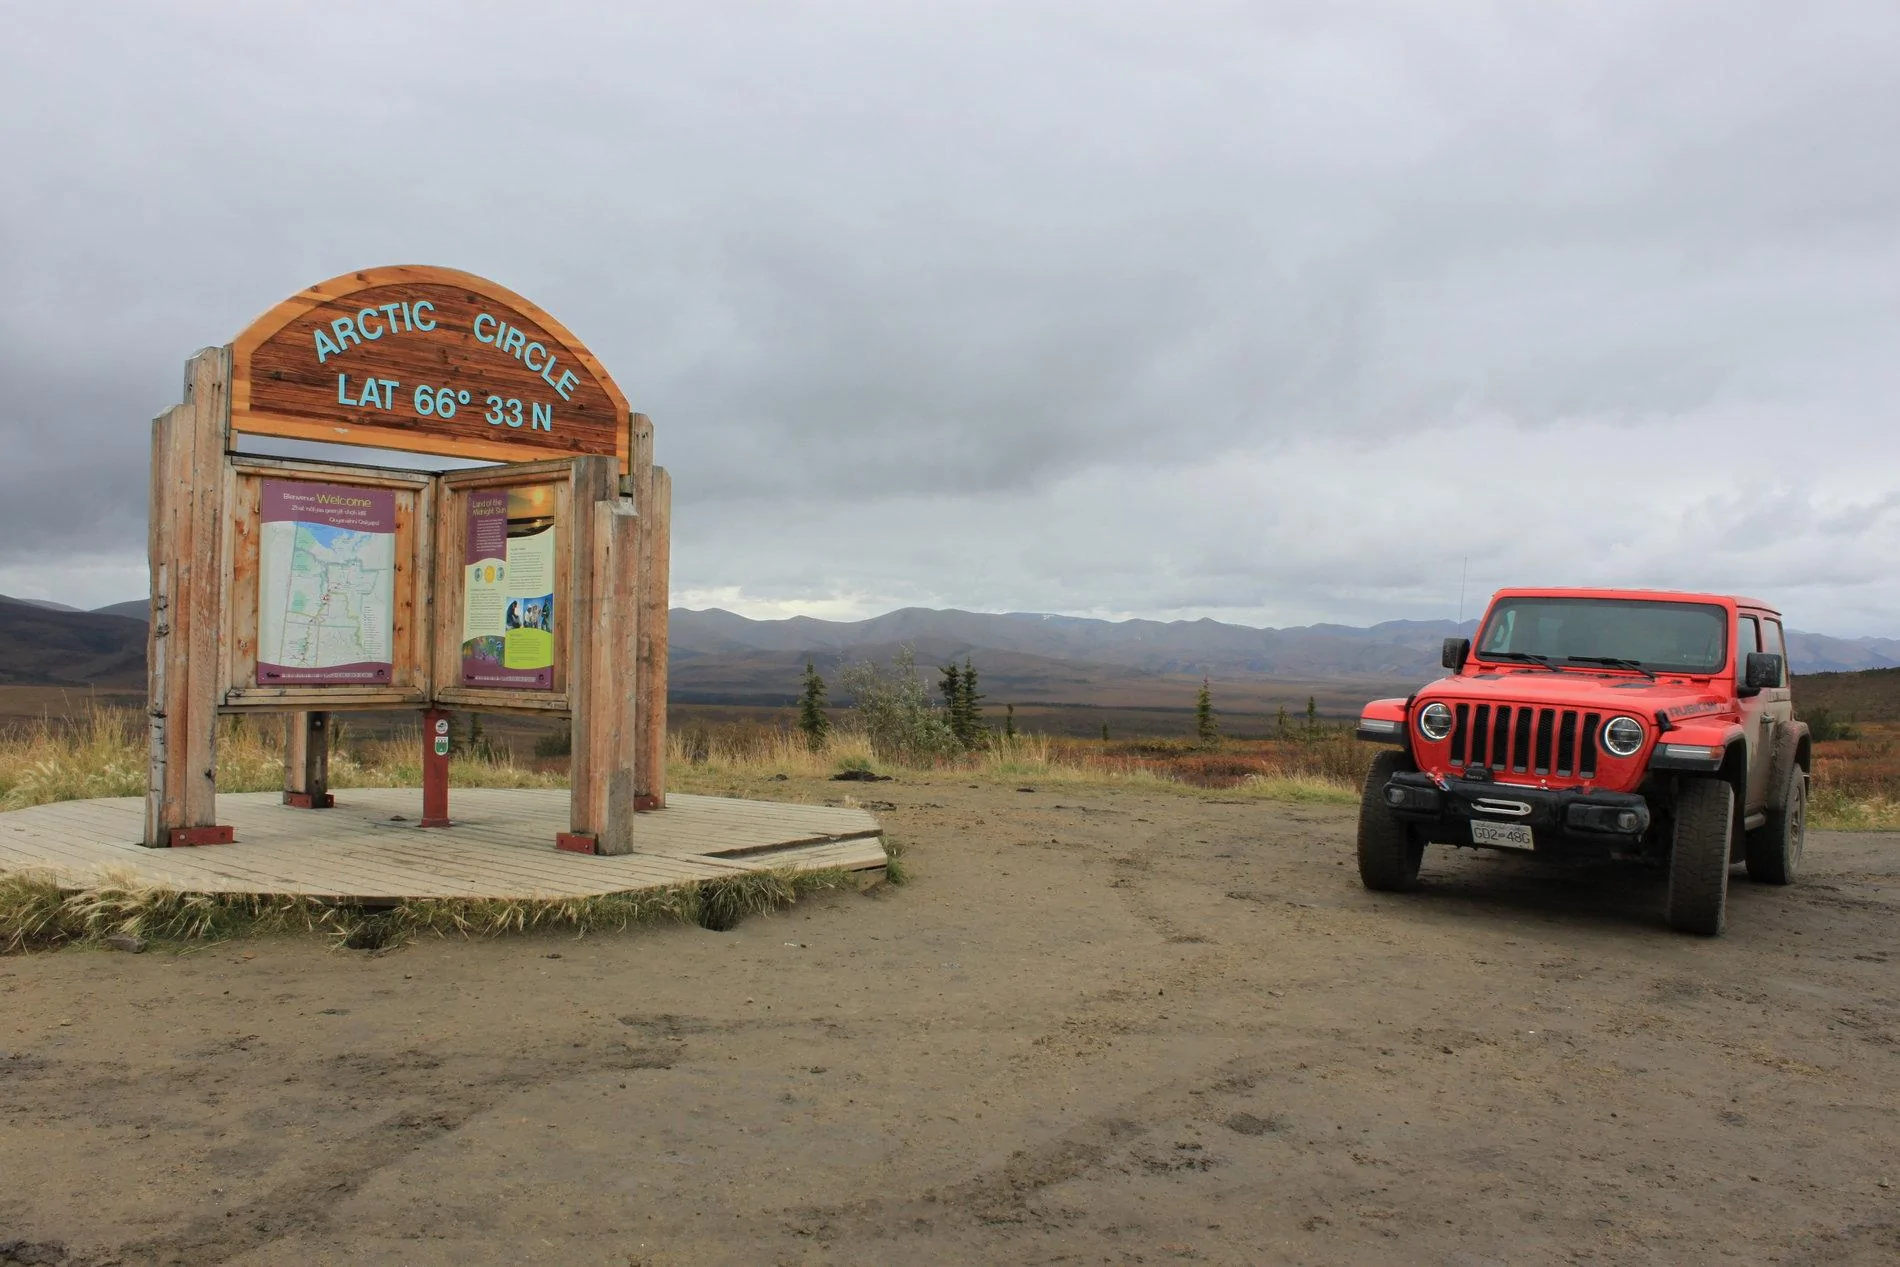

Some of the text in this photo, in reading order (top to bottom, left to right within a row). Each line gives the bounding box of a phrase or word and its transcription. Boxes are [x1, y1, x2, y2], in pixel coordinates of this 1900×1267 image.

[313, 300, 580, 401] ARCTIC CIRCLE
[338, 373, 399, 410] LAT
[485, 395, 524, 428] 33
[532, 402, 552, 432] N
[283, 492, 372, 508] Bienvenue Welcome
[472, 499, 485, 509] Land
[493, 498, 502, 506] the
[472, 506, 507, 517] Midnight Sun
[1669, 702, 1717, 717] RUBICON
